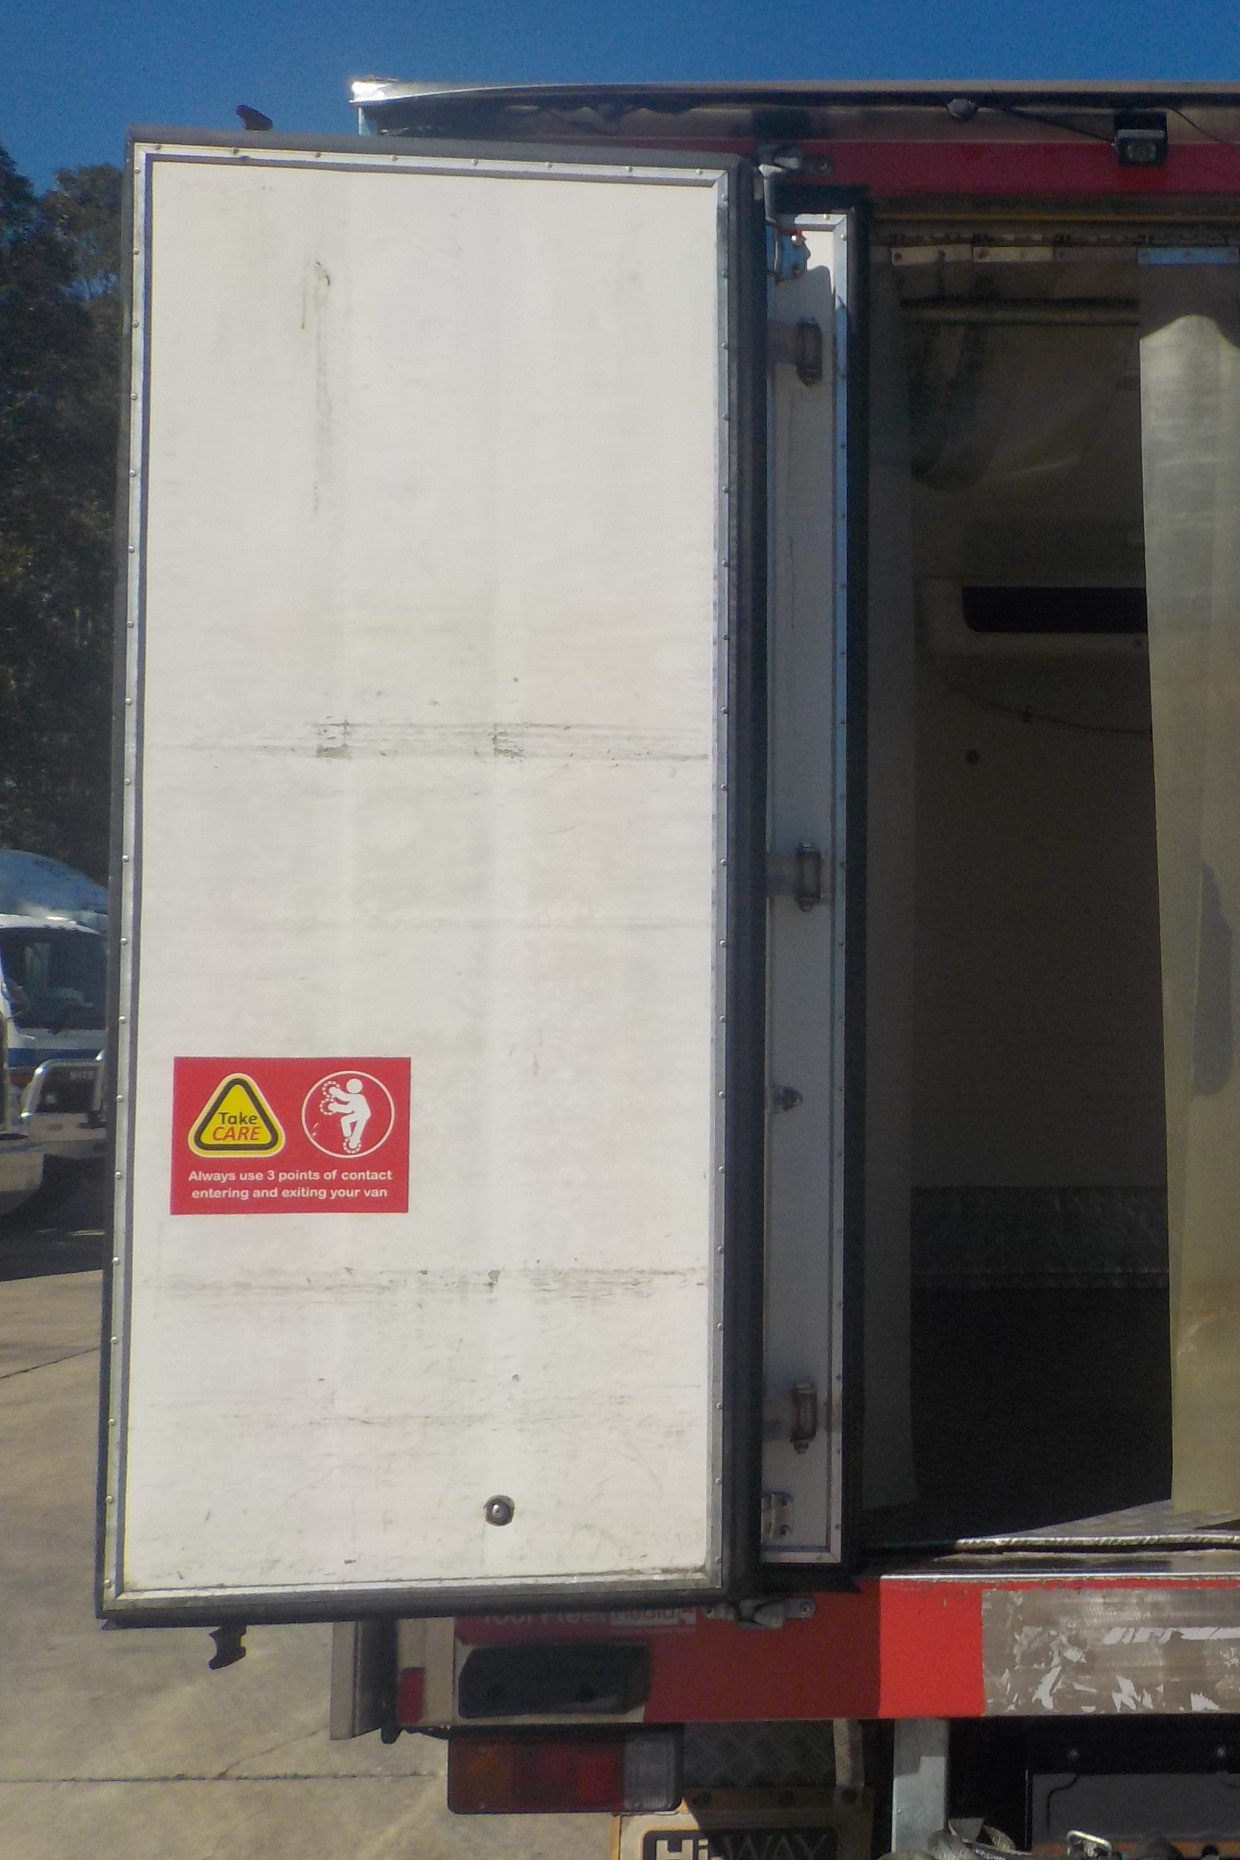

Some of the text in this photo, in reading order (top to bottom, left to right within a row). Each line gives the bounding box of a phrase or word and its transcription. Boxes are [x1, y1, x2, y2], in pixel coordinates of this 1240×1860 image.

[218, 1111, 258, 1125] Take
[212, 1126, 262, 1141] CARE
[188, 1169, 392, 1183] Always use 3 points of contact
[191, 1186, 388, 1200] entering and exiting your van
